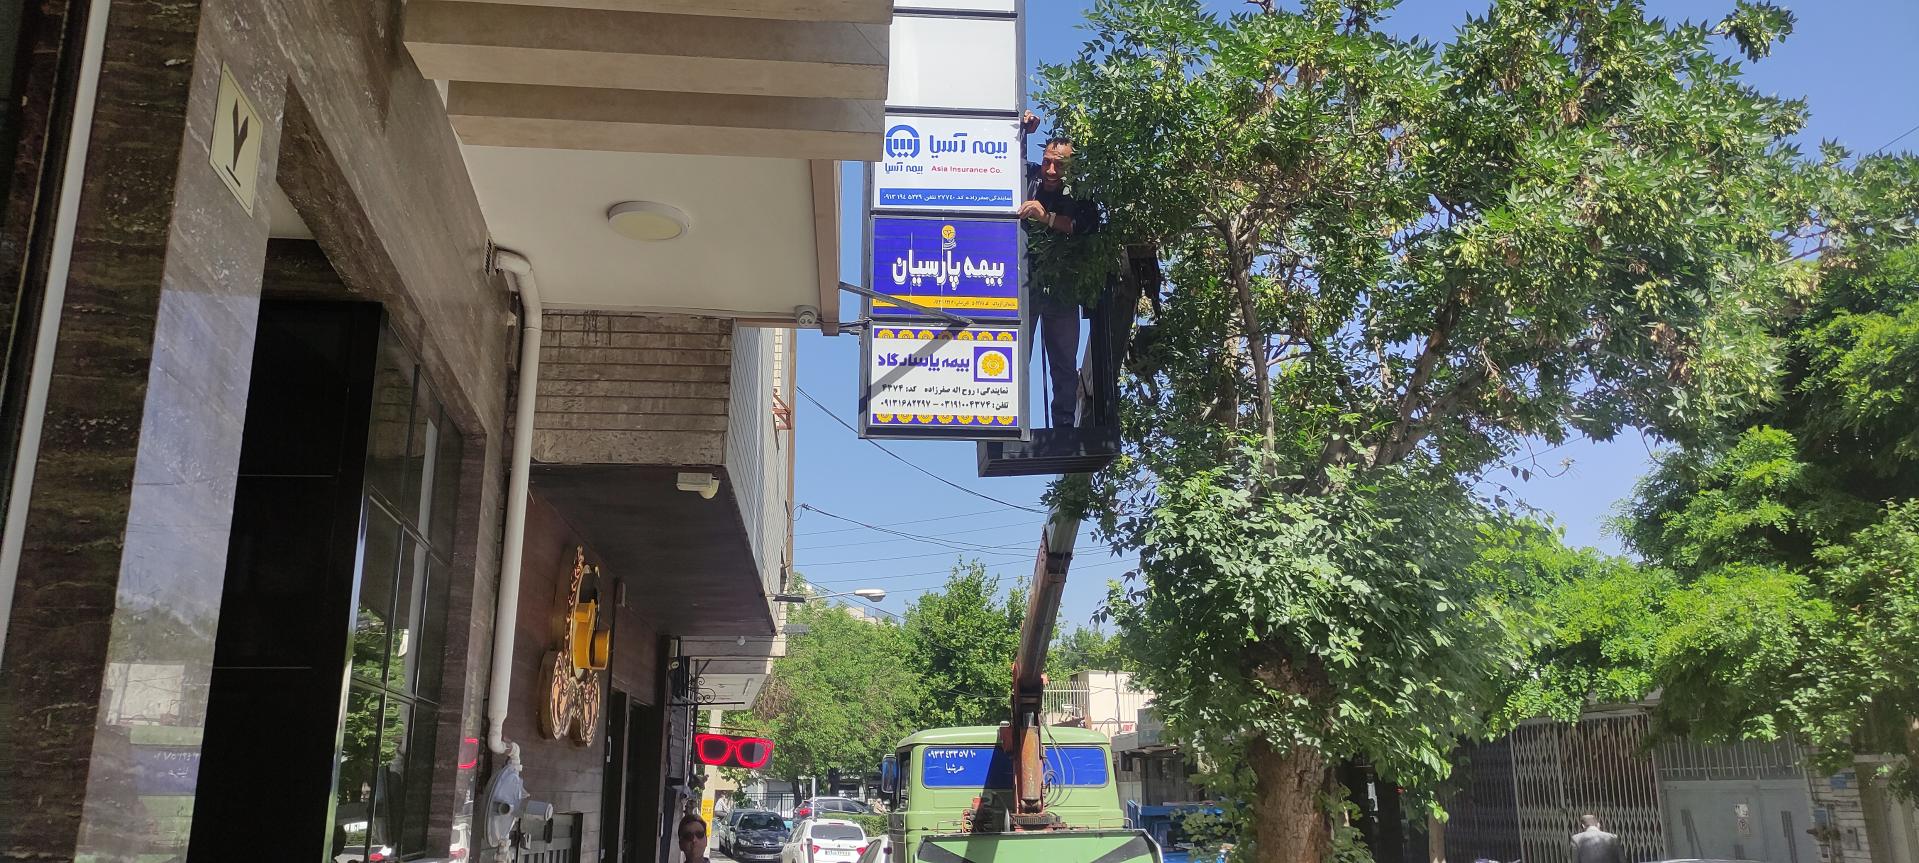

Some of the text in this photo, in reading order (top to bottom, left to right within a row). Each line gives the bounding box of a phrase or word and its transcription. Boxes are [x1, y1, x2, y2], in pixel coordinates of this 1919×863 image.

[929, 132, 1008, 160] بیمه آسیا
[884, 161, 924, 175] بیمه آسیا
[931, 164, 1002, 174] Asia Insurance Co.
[891, 249, 1006, 291] بیمه پارسیان
[877, 352, 970, 372] بیمه پاسارگاد
[924, 385, 951, 395] صفرزاده
[961, 387, 976, 396] روح
